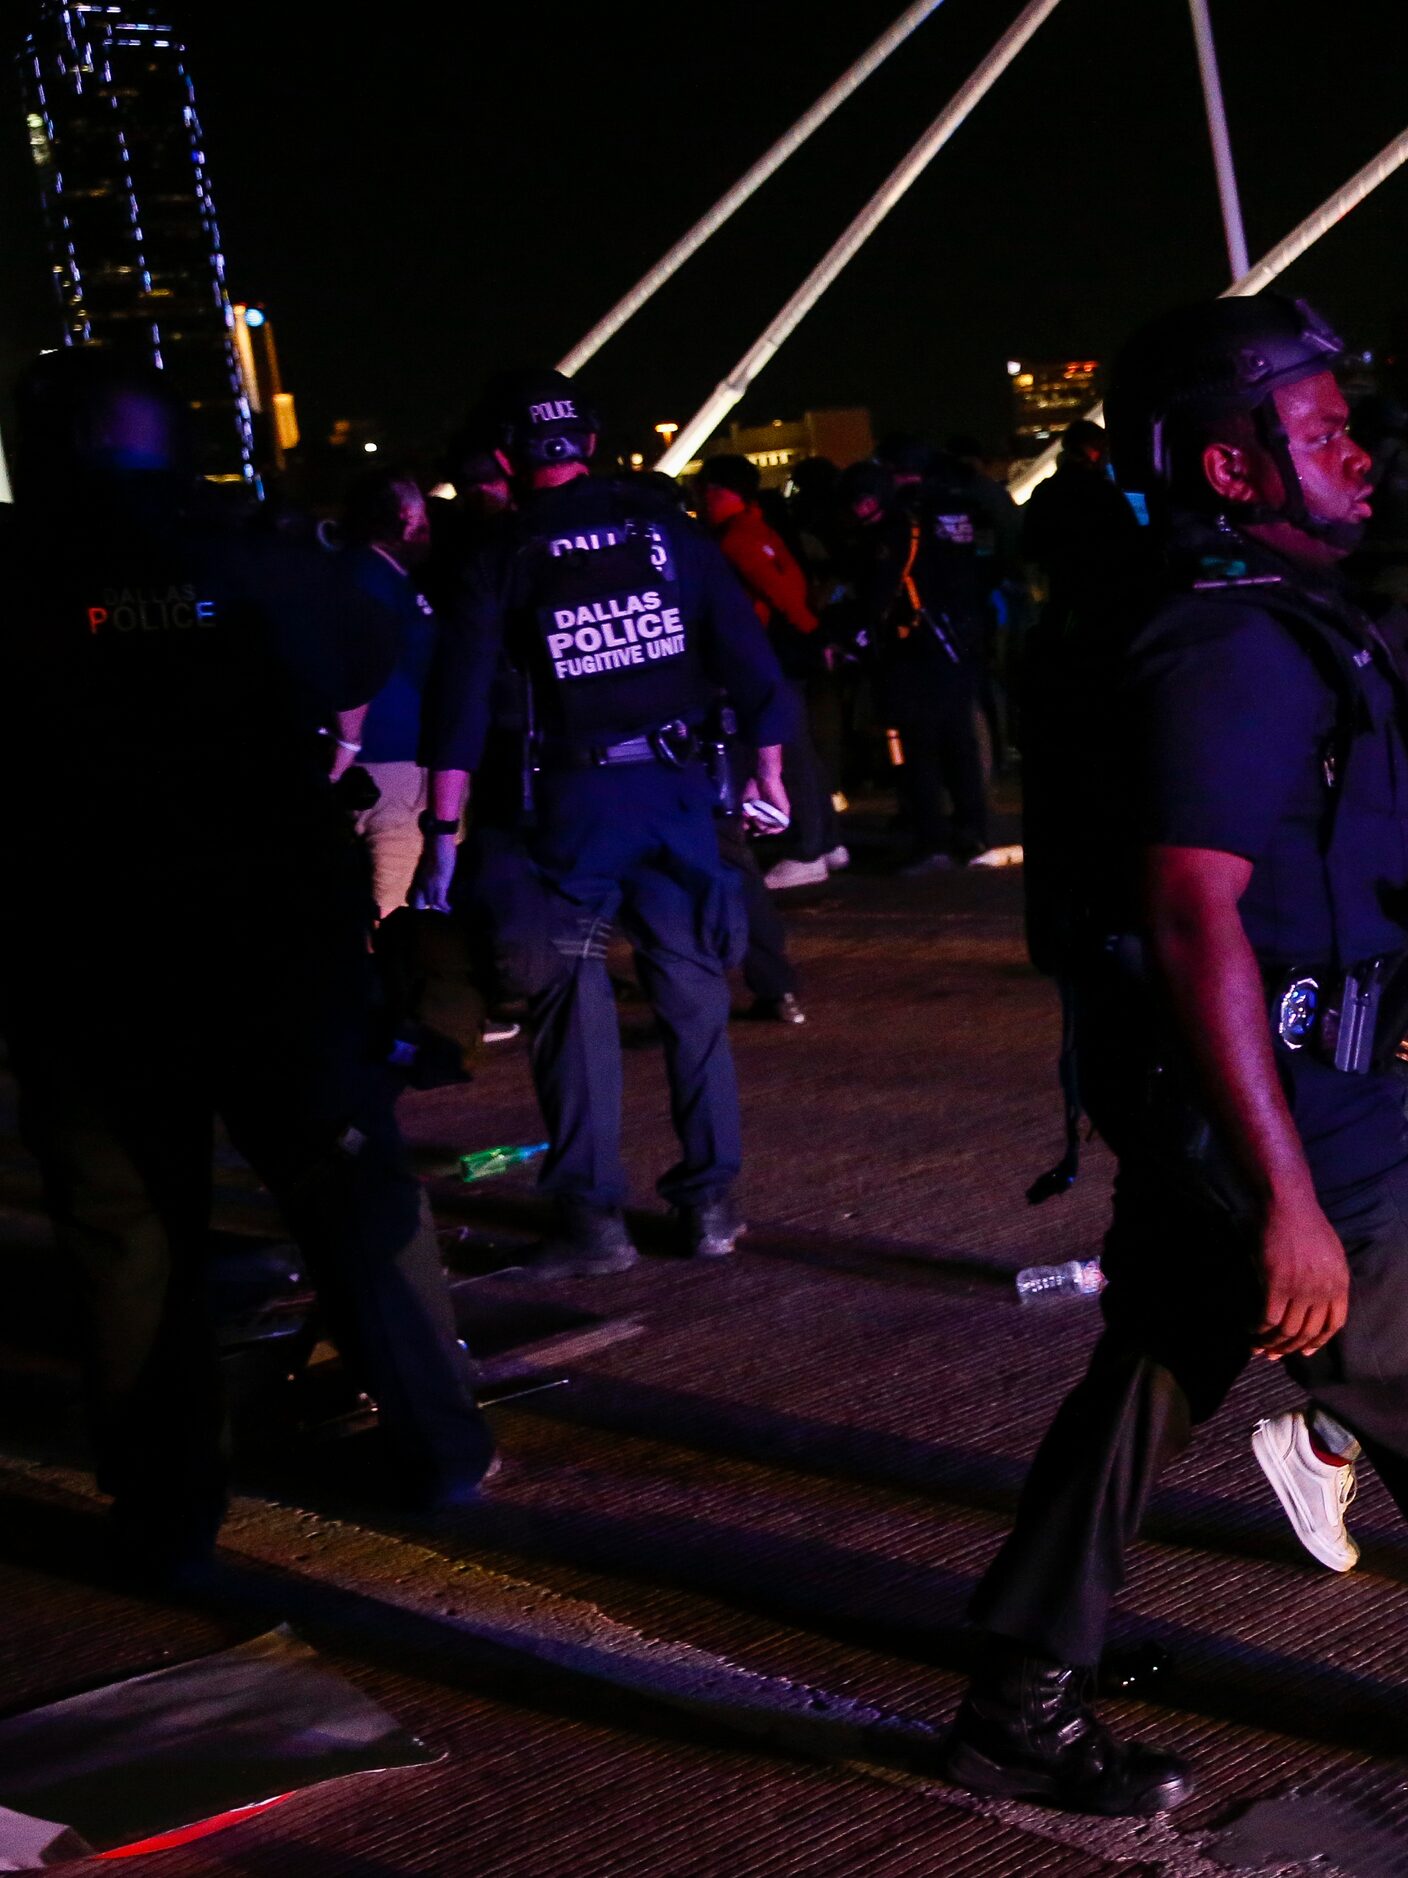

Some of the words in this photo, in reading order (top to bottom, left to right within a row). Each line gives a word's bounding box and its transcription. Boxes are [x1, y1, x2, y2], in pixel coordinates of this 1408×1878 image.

[529, 400, 578, 423] POLICE
[87, 600, 216, 634] POLICE
[554, 591, 662, 629] DALLAS
[547, 607, 684, 659] POLICE
[554, 644, 645, 679] FUGITIVE
[646, 634, 686, 659] UNIT
